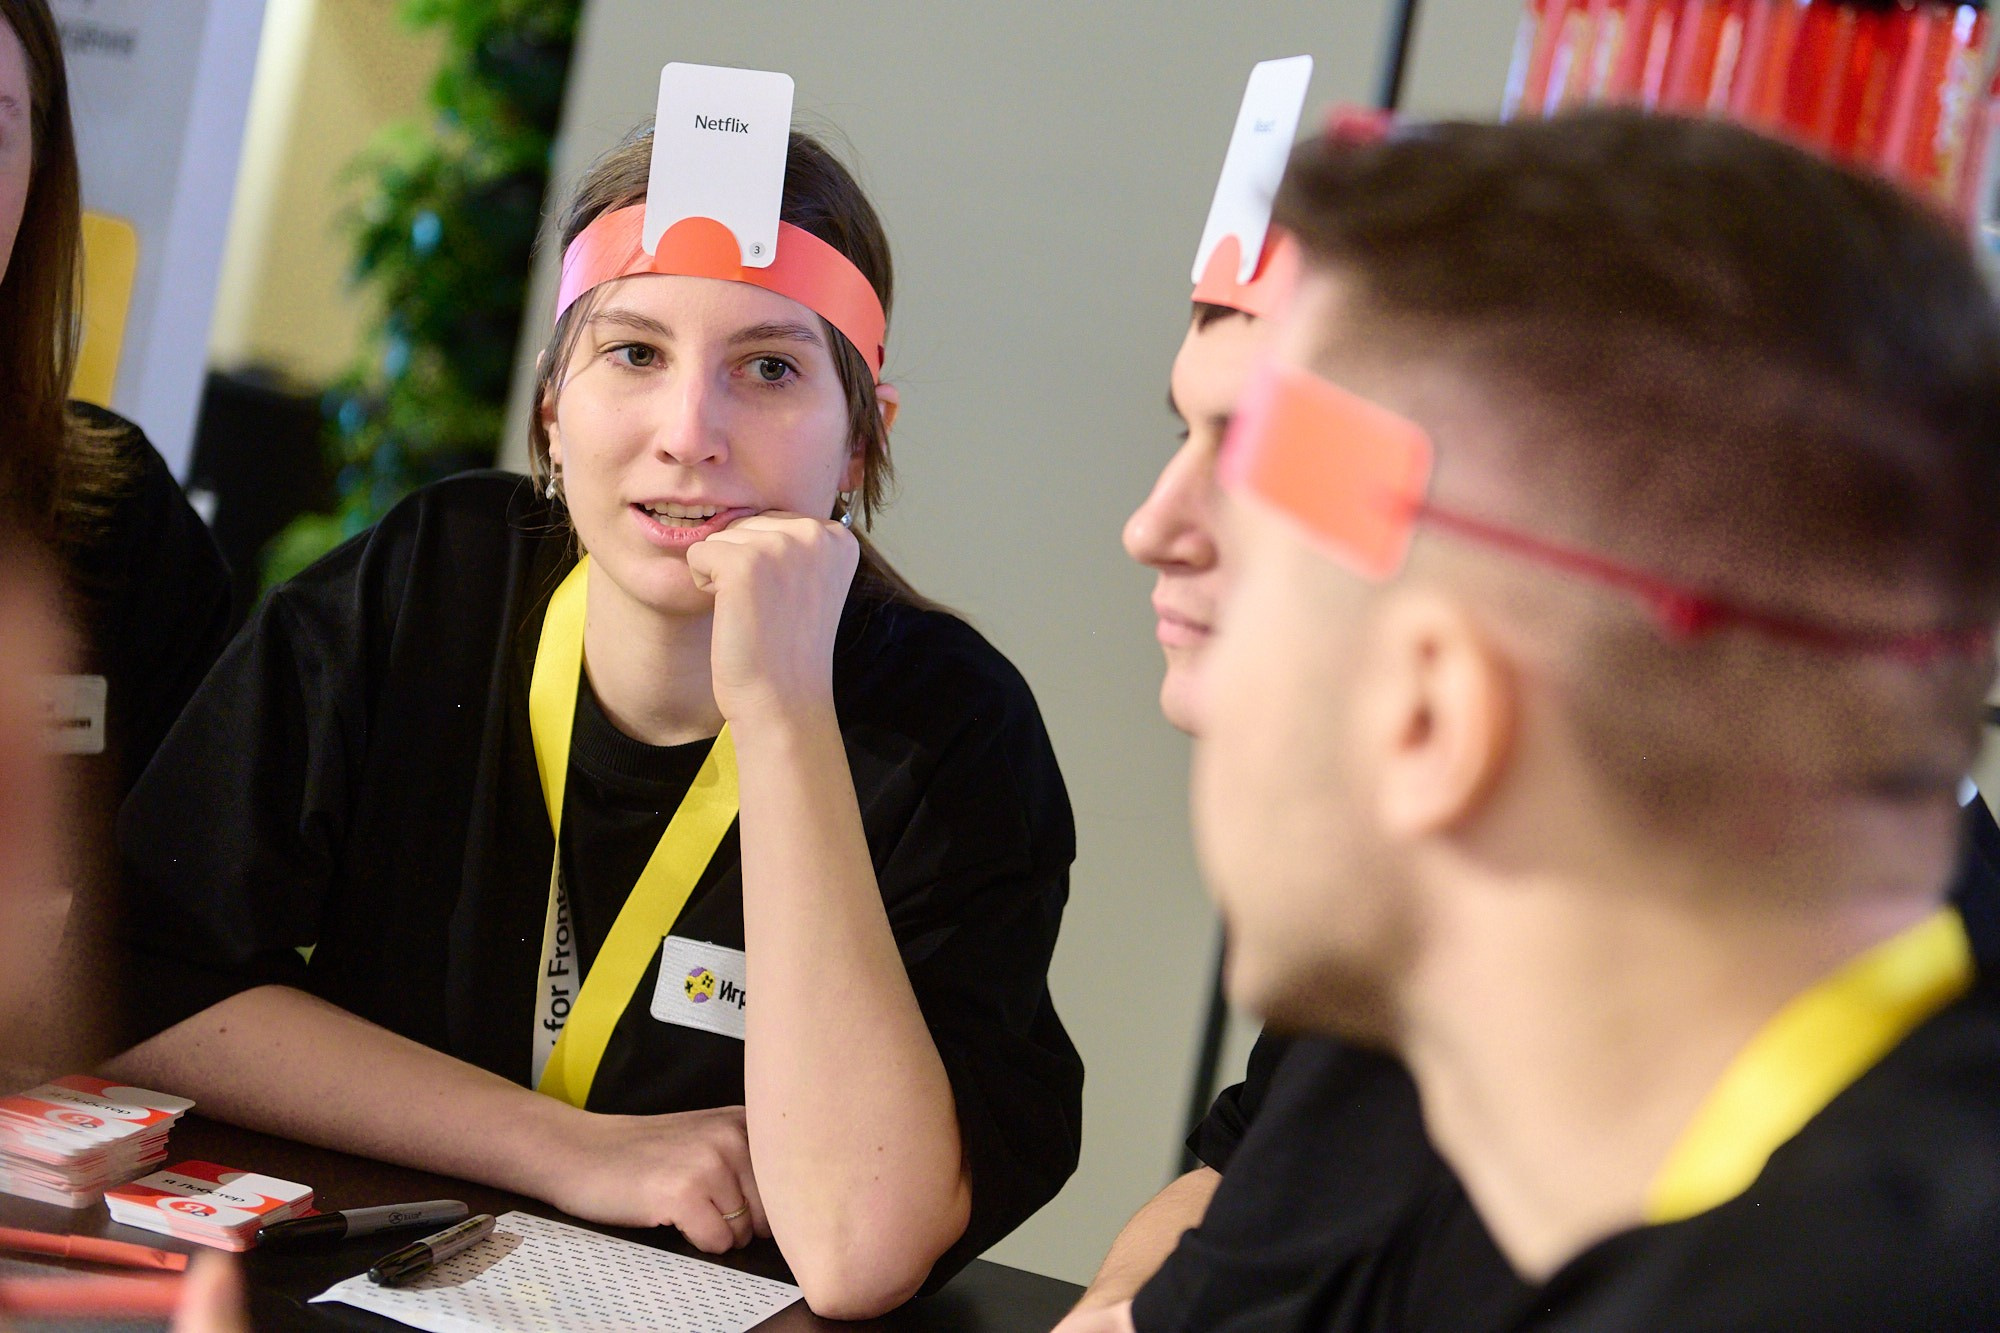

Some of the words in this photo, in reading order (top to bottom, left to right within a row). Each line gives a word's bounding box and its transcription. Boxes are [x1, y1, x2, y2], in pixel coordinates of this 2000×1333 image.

[694, 114, 750, 134] Netflix
[753, 245, 761, 254] 3
[543, 984, 570, 1030] for
